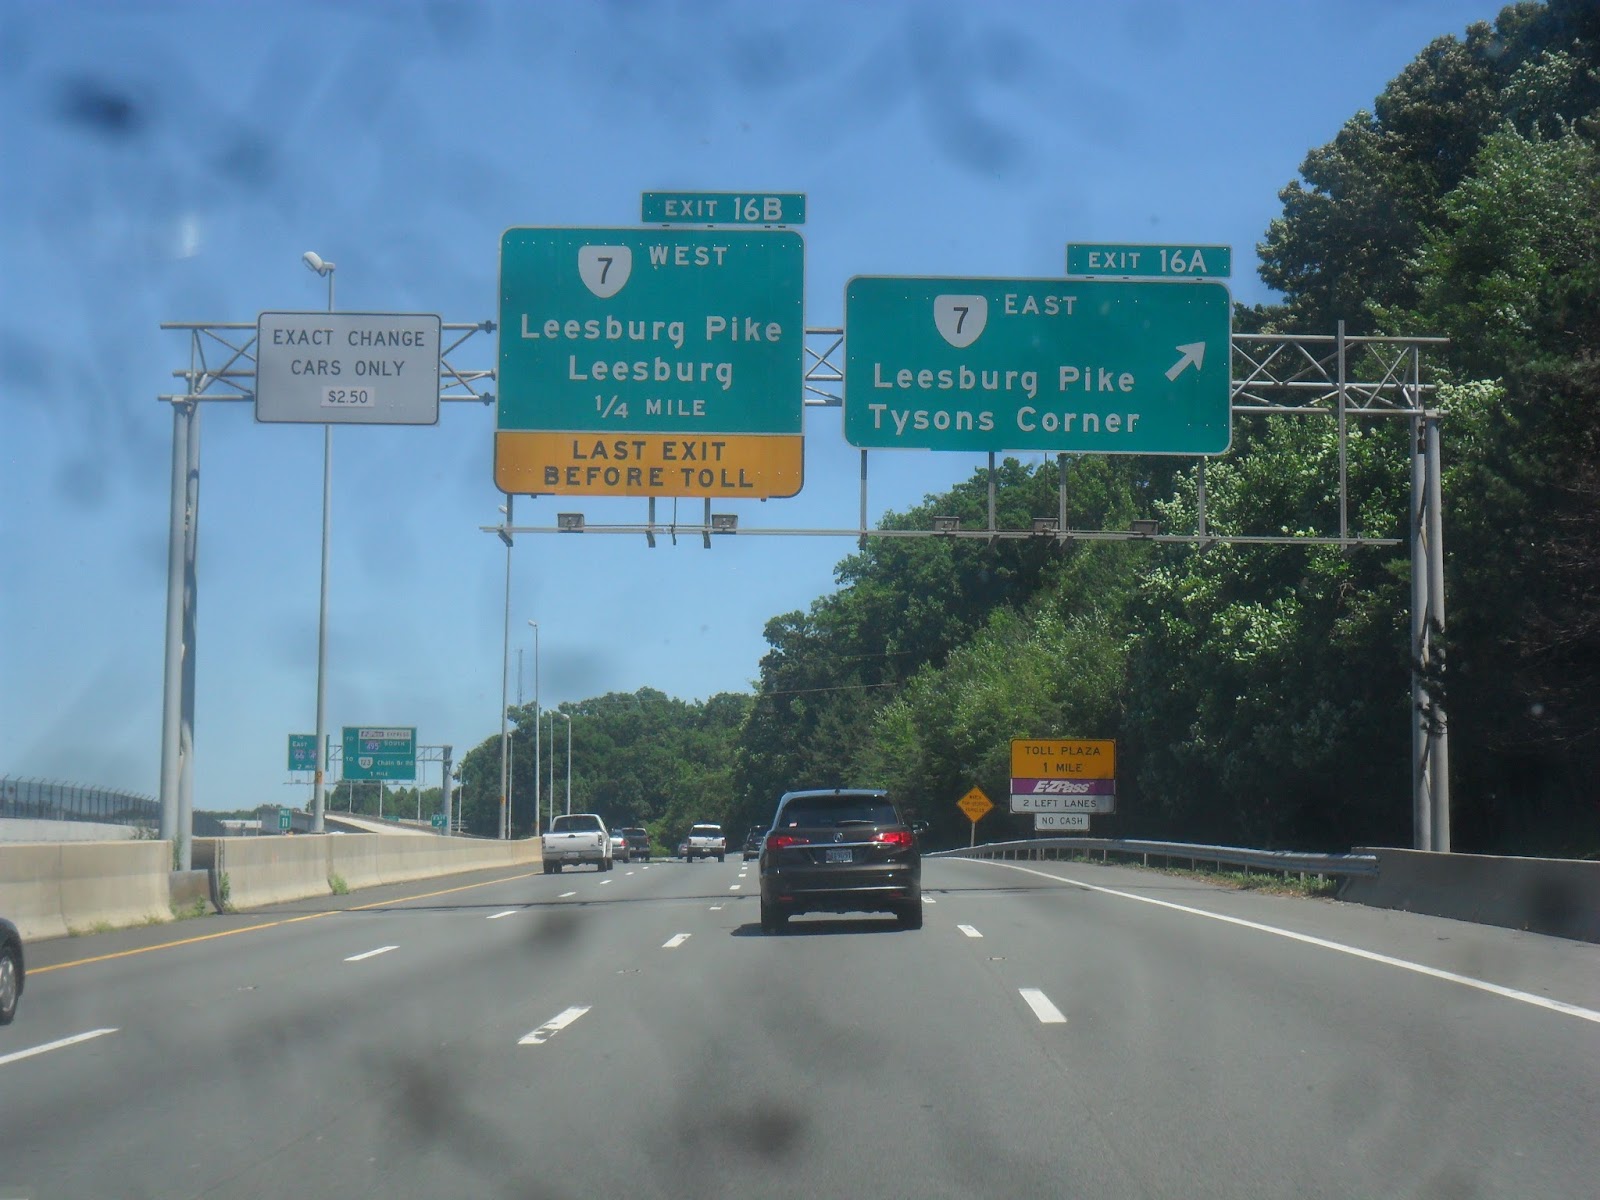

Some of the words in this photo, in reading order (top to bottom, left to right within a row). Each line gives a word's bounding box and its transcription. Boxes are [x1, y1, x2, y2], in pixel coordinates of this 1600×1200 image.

[665, 200, 717, 217] EXIT
[734, 198, 783, 221] 16B
[597, 257, 613, 284] 7
[649, 246, 728, 266] WEST
[1089, 252, 1140, 269] EXIT
[1159, 249, 1207, 273] 16A
[953, 306, 969, 334] 7
[1005, 294, 1077, 315] EAST
[273, 330, 334, 345] EXACT
[348, 331, 425, 347] CHANGE
[521, 313, 685, 349] Leesburg
[706, 316, 782, 341] Pike
[291, 360, 341, 375] CARS
[355, 361, 405, 376] ONLY
[569, 355, 733, 390] Leesburg
[874, 363, 1038, 399] Leesburg
[1059, 366, 1135, 393] Pike
[328, 390, 368, 403] $2.50
[595, 395, 628, 418] 1/4
[646, 399, 706, 416] MILE
[868, 404, 994, 435] Tysons
[1016, 406, 1140, 433] Corner
[573, 440, 647, 460] LAST
[663, 442, 726, 461] EXIT
[544, 466, 664, 486] BEFORE
[681, 468, 754, 488] TOLL
[1025, 747, 1054, 755] TOLL
[1061, 747, 1101, 755] PLAZA
[1044, 763, 1047, 772] 1
[1056, 764, 1082, 772] MILE
[1065, 800, 1096, 808] LANES
